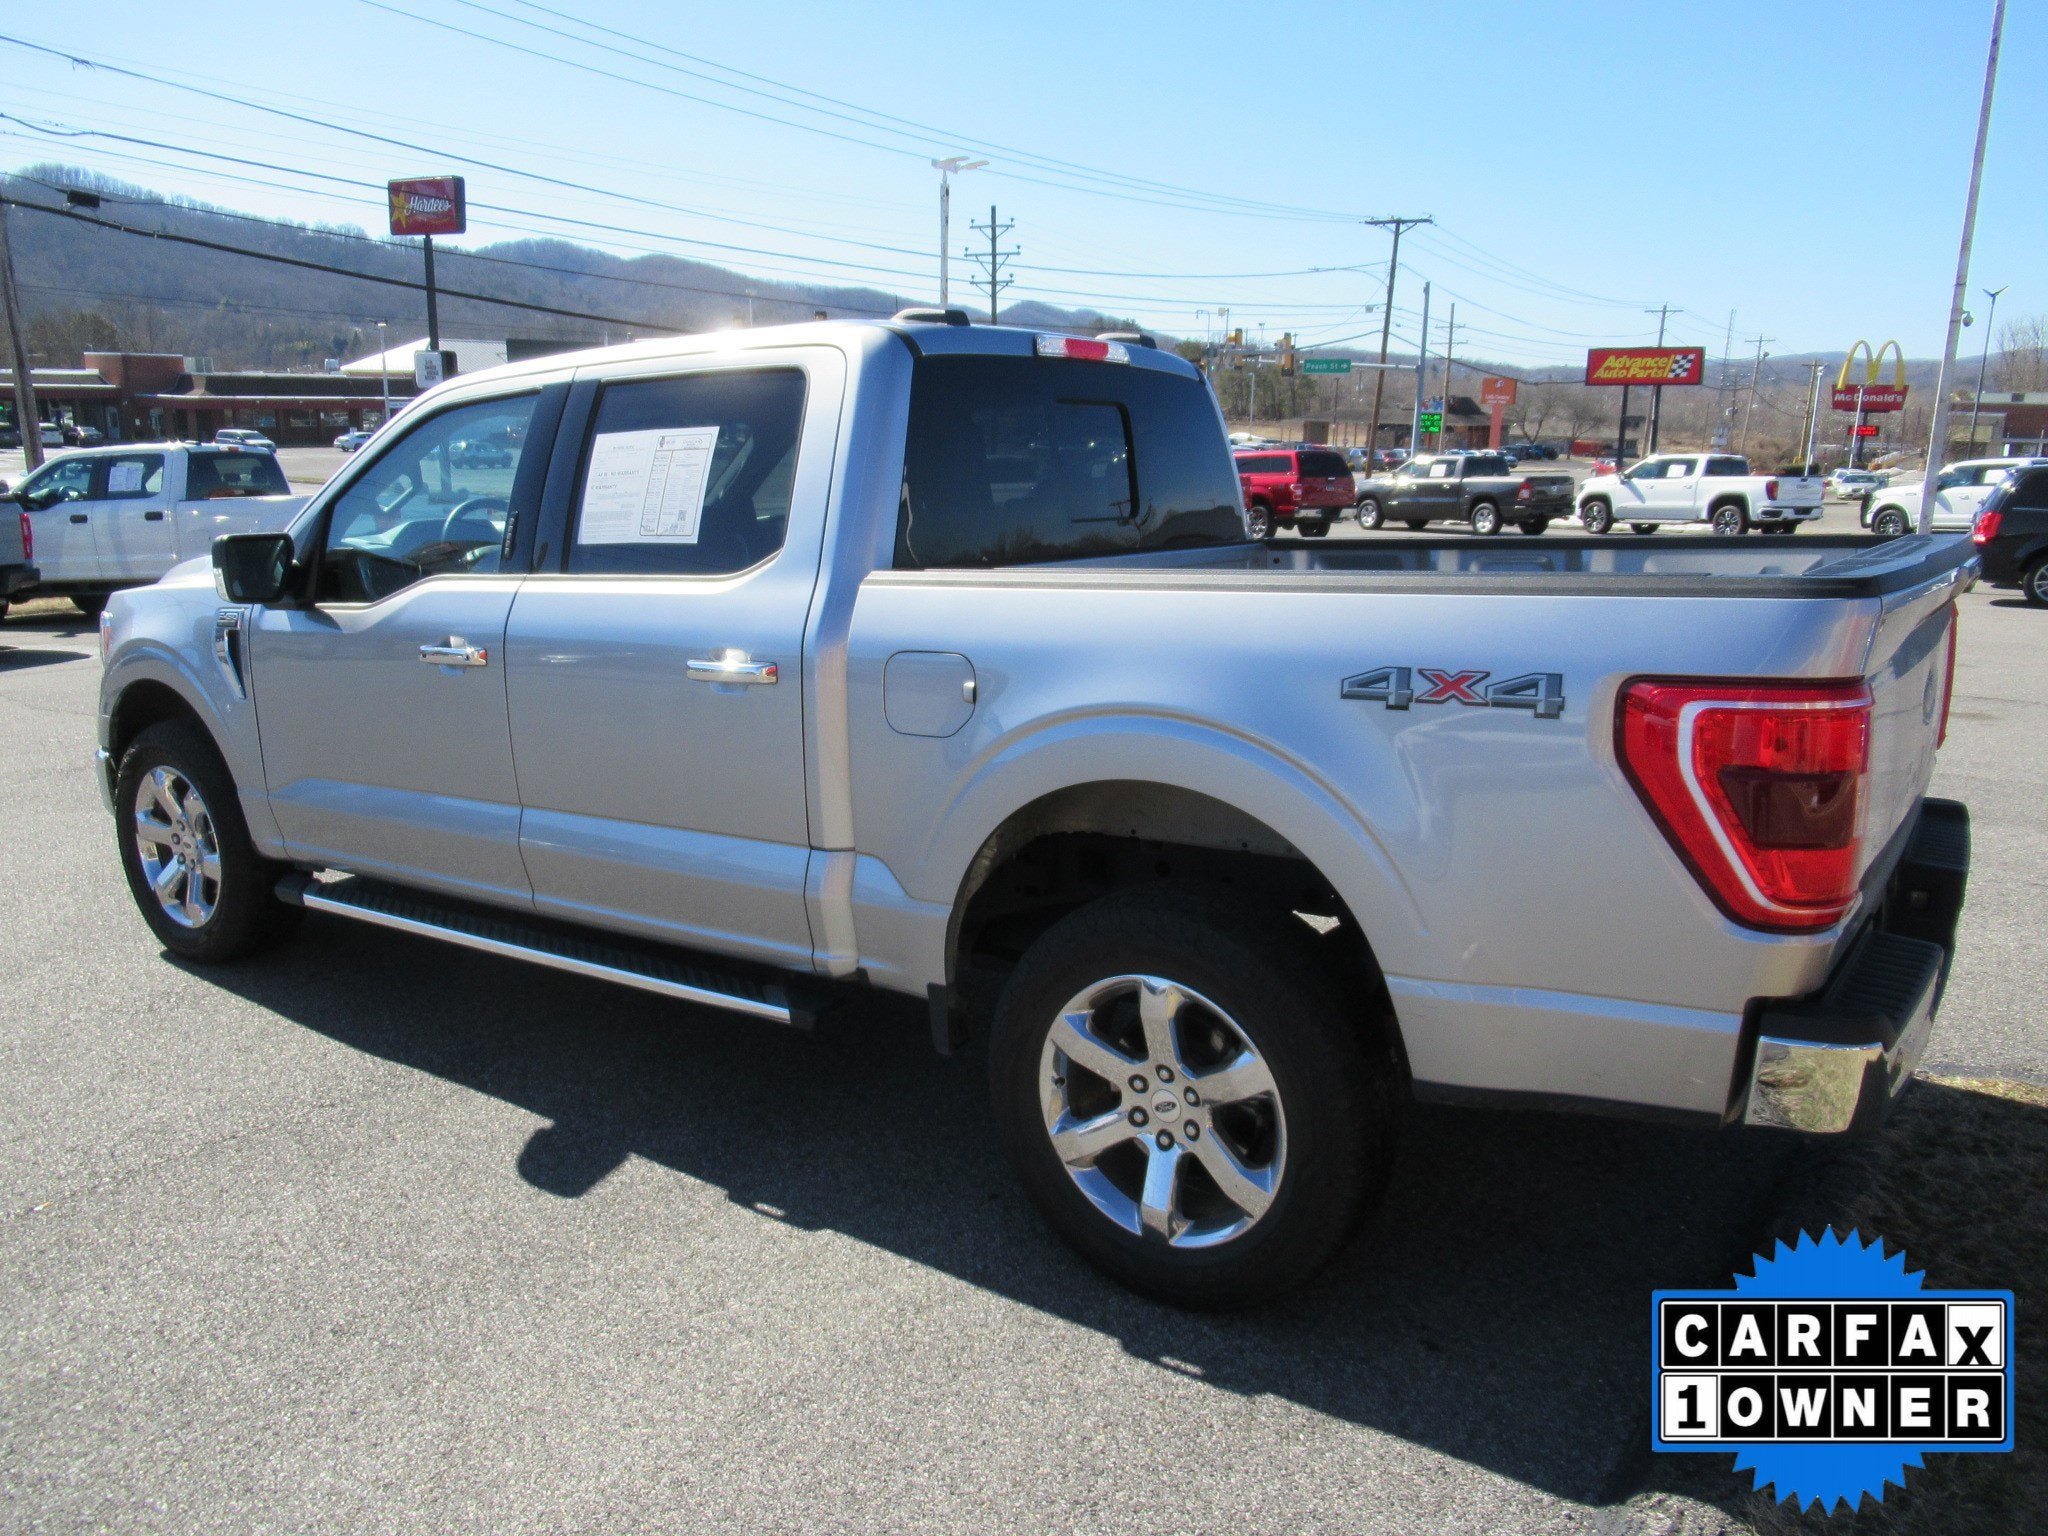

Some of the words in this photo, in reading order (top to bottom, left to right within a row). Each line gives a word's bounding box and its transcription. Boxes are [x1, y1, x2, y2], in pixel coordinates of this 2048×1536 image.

[404, 195, 451, 215] Hardee's
[1605, 355, 1668, 367] Advance
[1593, 367, 1627, 378] Auto
[1627, 367, 1664, 378] Parts
[1834, 393, 1904, 402] McDonald's
